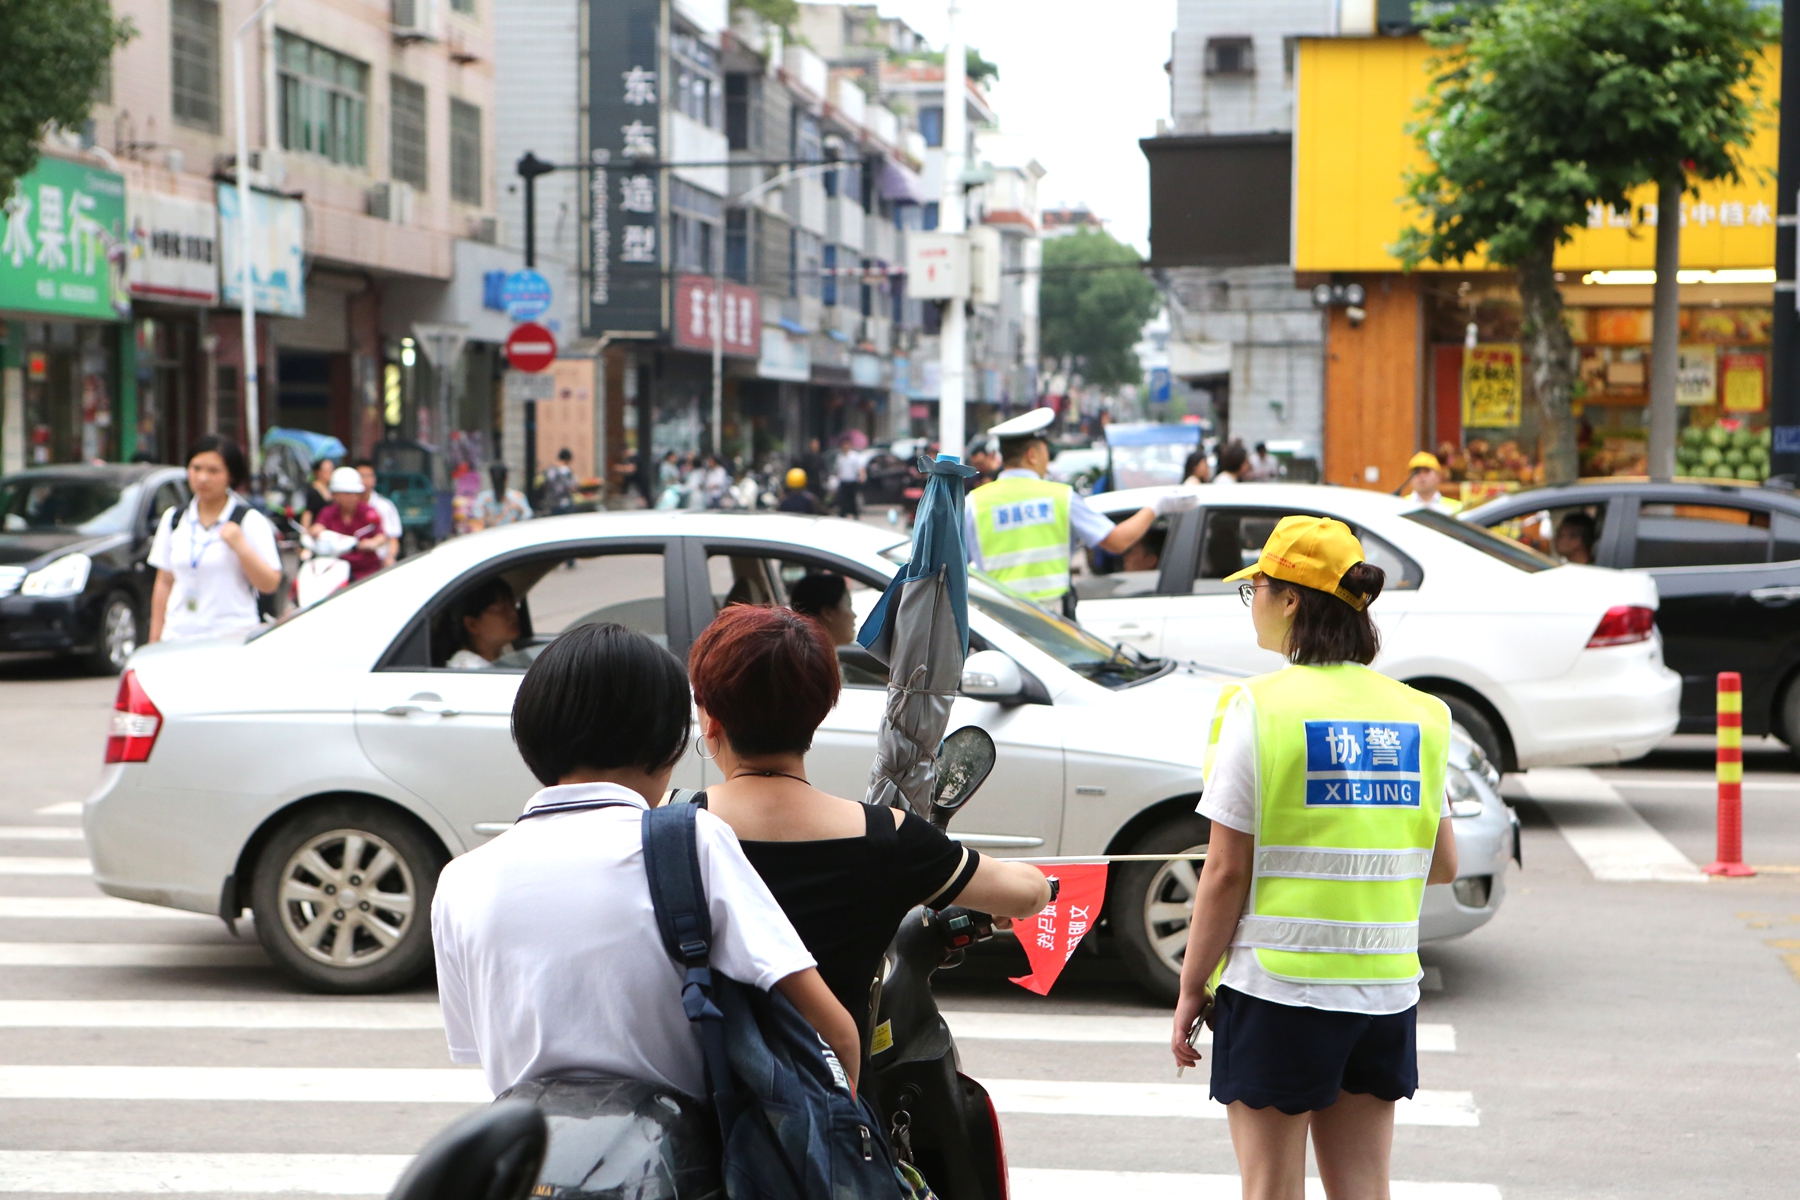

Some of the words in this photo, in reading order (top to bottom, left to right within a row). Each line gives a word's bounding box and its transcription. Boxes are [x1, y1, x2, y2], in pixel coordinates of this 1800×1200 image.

[3, 180, 97, 277] 水果行
[1325, 726, 1402, 766] 协警
[1324, 782, 1413, 802] XIEJING
